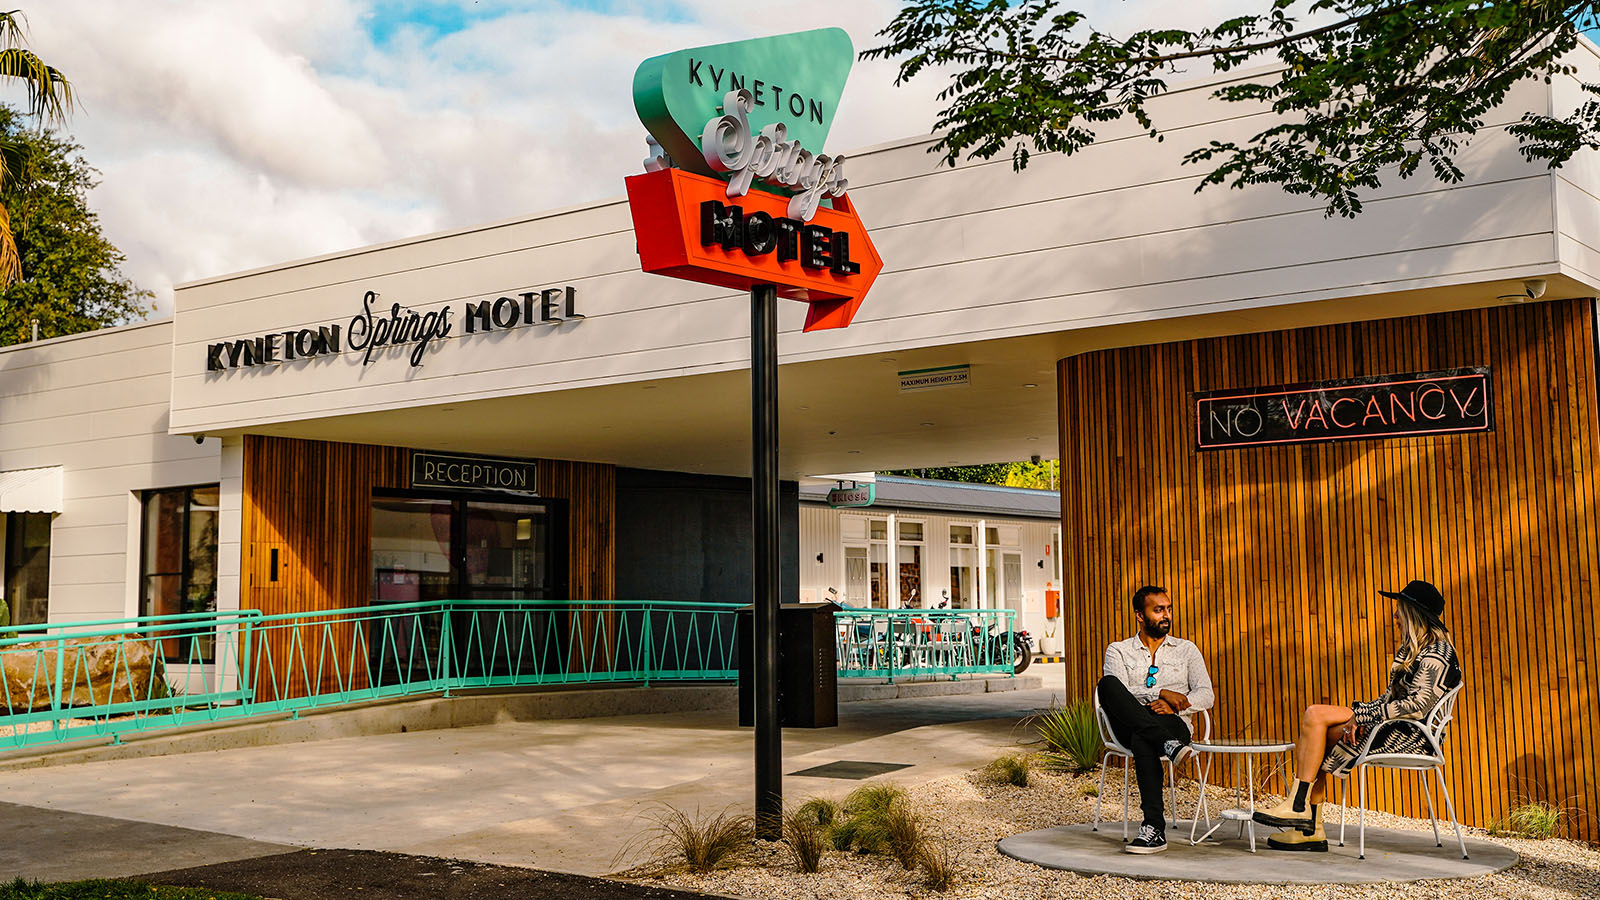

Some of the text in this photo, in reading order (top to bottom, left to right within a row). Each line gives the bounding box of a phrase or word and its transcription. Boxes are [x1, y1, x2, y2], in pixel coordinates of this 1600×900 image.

[689, 58, 823, 125] KYNETON
[702, 89, 848, 221] Springs
[700, 200, 860, 275] MOTEL
[207, 286, 586, 372] KYNETON Springs MOTEL
[901, 373, 968, 387] MAXIMUM HEIGHT 2.5M
[1210, 387, 1478, 439] NO VACANCY
[424, 461, 526, 487] RECEPTION
[837, 492, 868, 503] KIOSK
